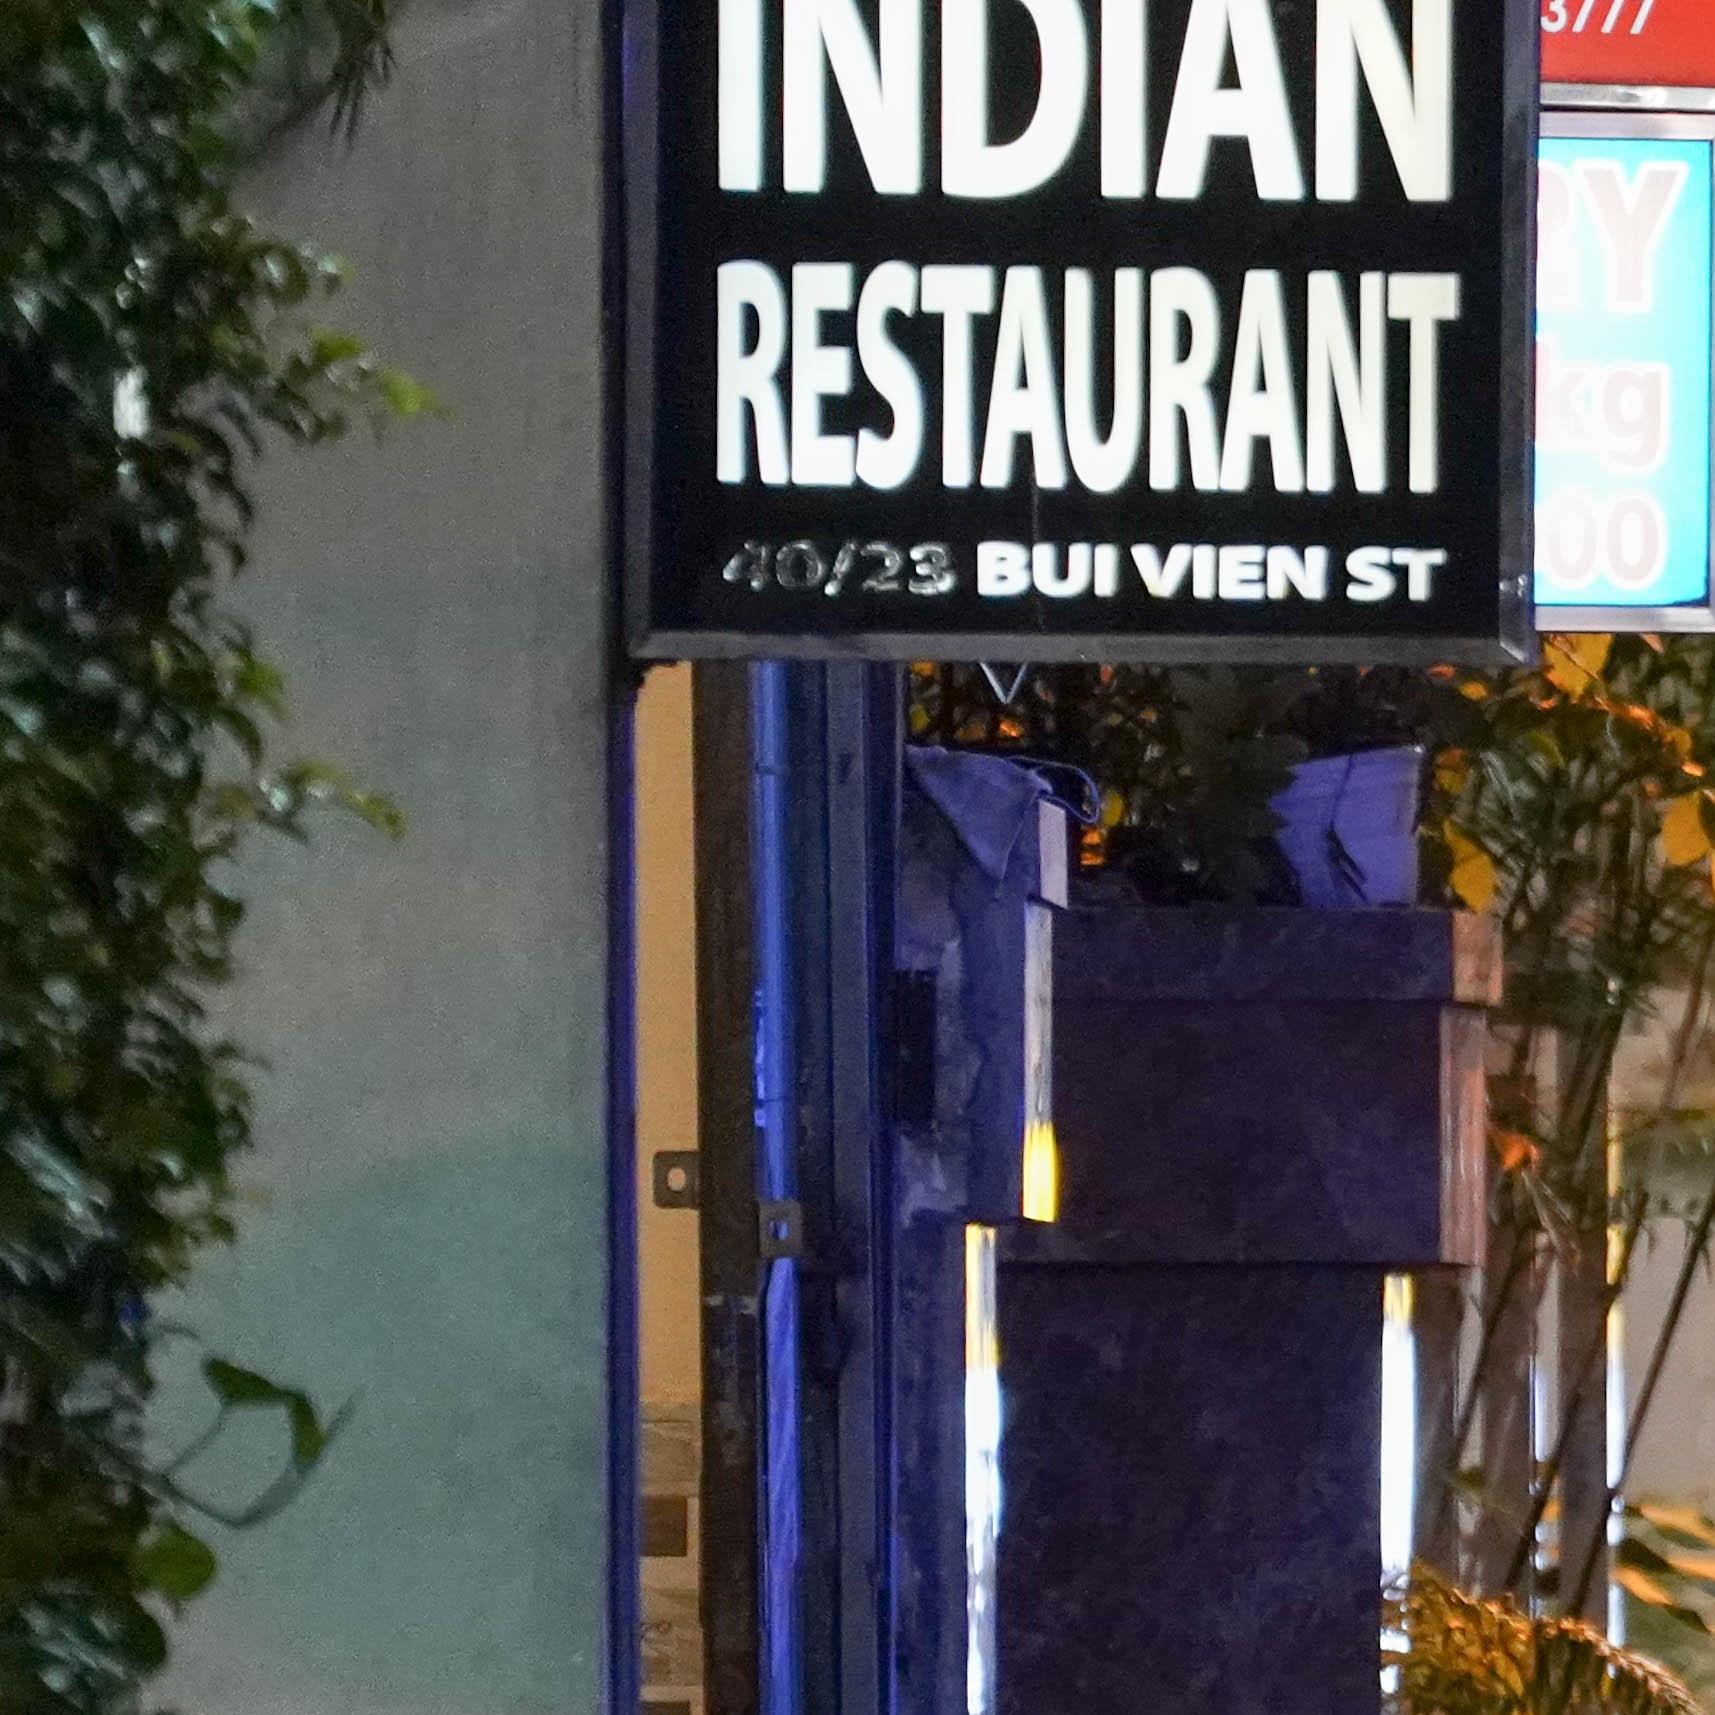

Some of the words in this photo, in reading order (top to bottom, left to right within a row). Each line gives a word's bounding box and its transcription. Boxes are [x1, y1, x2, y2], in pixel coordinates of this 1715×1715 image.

[718, 0, 1454, 201] INDIAN
[716, 259, 1461, 494] RESTAURANT
[722, 539, 958, 598] 40/23
[976, 540, 1118, 598] BUI
[1130, 543, 1328, 601] VIEN
[1344, 545, 1448, 602] ST
